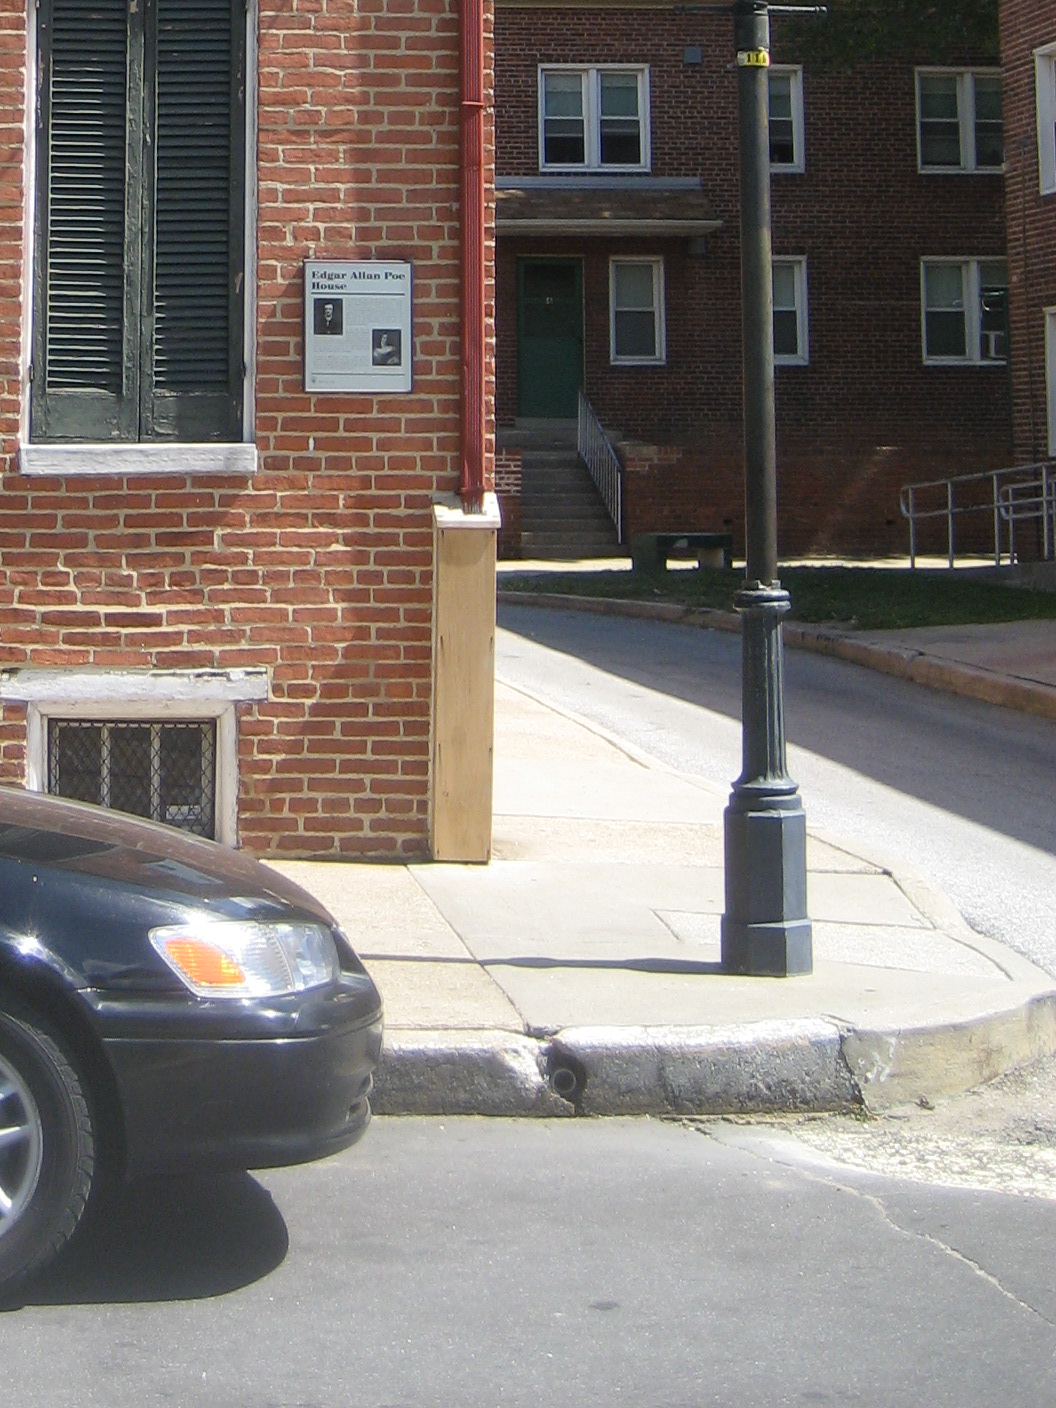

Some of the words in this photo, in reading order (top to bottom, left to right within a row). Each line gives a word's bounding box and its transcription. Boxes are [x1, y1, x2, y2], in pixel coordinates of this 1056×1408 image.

[311, 271, 347, 281] Edgar
[350, 271, 381, 280] Allan
[384, 271, 406, 280] Poe
[311, 282, 347, 290] House
